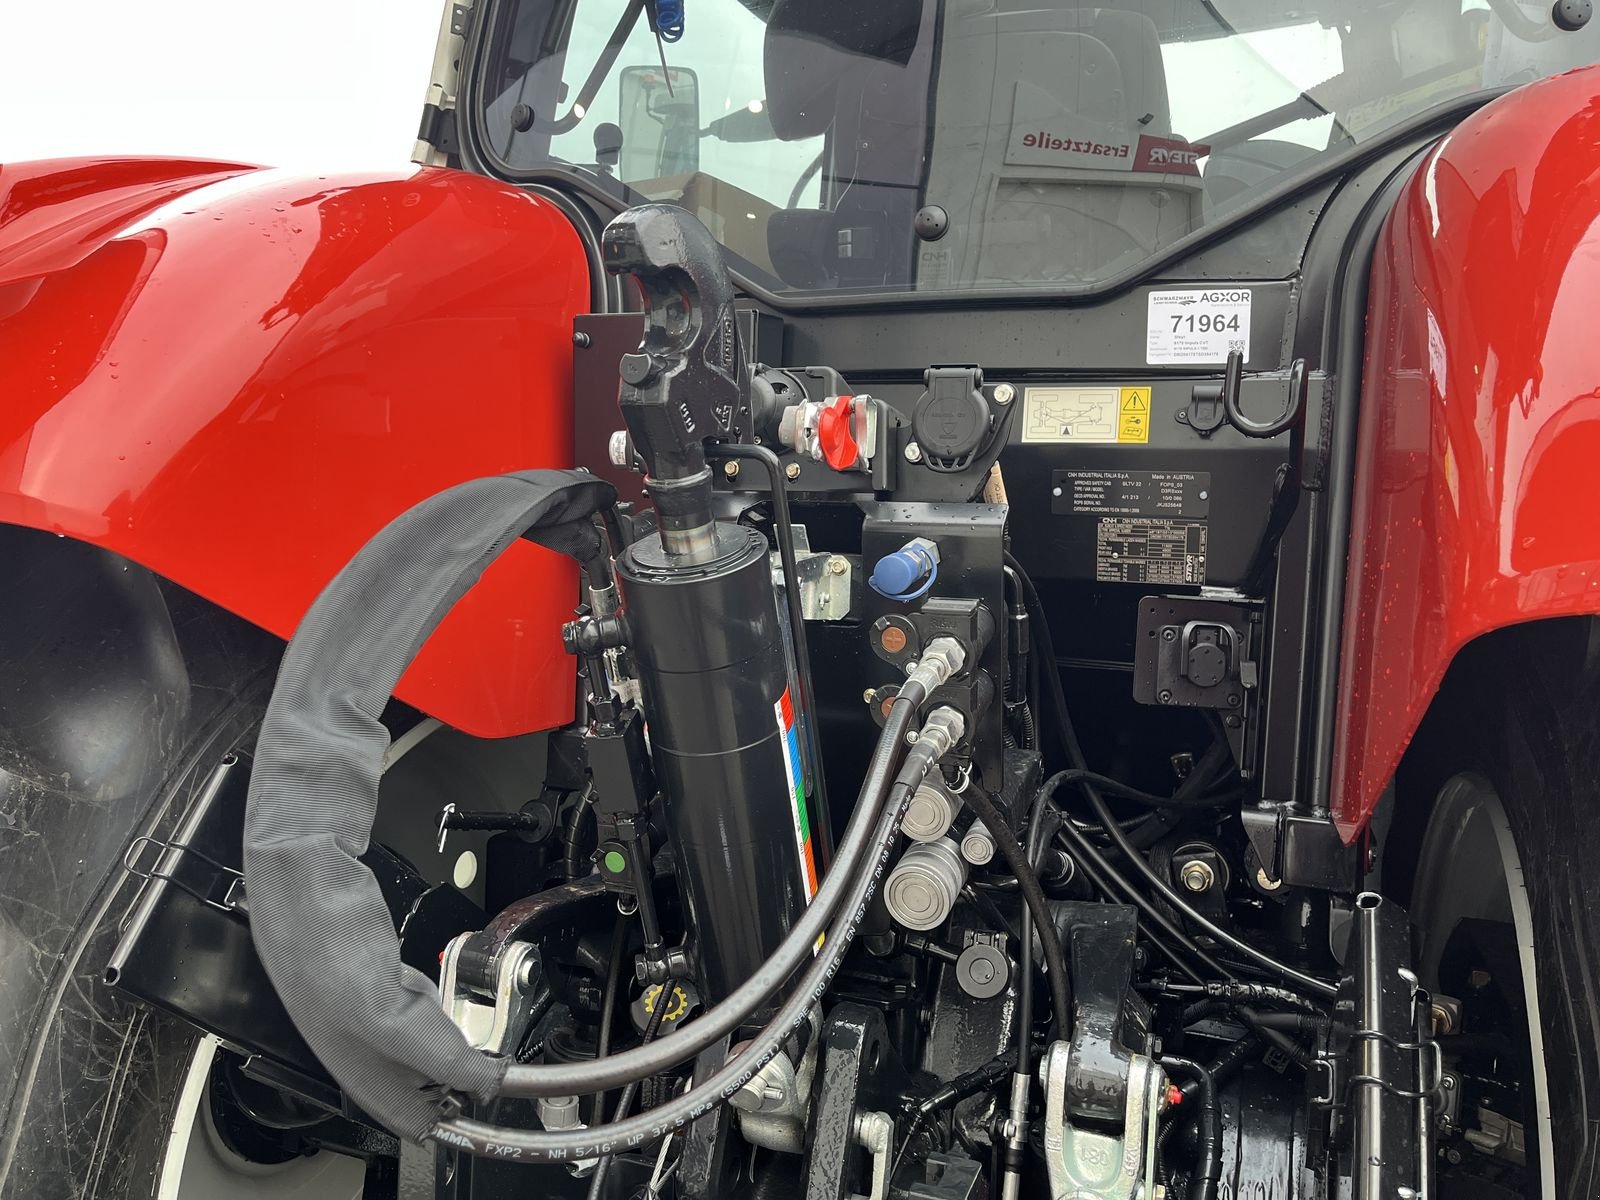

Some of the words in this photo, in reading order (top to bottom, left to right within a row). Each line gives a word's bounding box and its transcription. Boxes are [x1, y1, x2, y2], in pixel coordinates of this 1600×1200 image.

[1200, 292, 1250, 302] AGXOR
[1170, 314, 1240, 333] 71964
[485, 1143, 522, 1158] FXP2
[548, 1148, 567, 1159] NH
[576, 1140, 617, 1157] 5/16"
[627, 1134, 644, 1146] WP
[652, 1118, 684, 1138] 37.5
[690, 1101, 713, 1119] MPa
[720, 1071, 752, 1099] (5500
[756, 1044, 779, 1070] PSI)
[793, 1006, 811, 1029] SAE
[810, 982, 826, 1001] 100
[826, 957, 842, 979] R16
[846, 926, 857, 943] EN
[854, 903, 867, 924] 857
[865, 881, 877, 902] 2SC
[874, 864, 884, 879] DN
[881, 850, 890, 863] 08
[887, 834, 895, 848] 10
